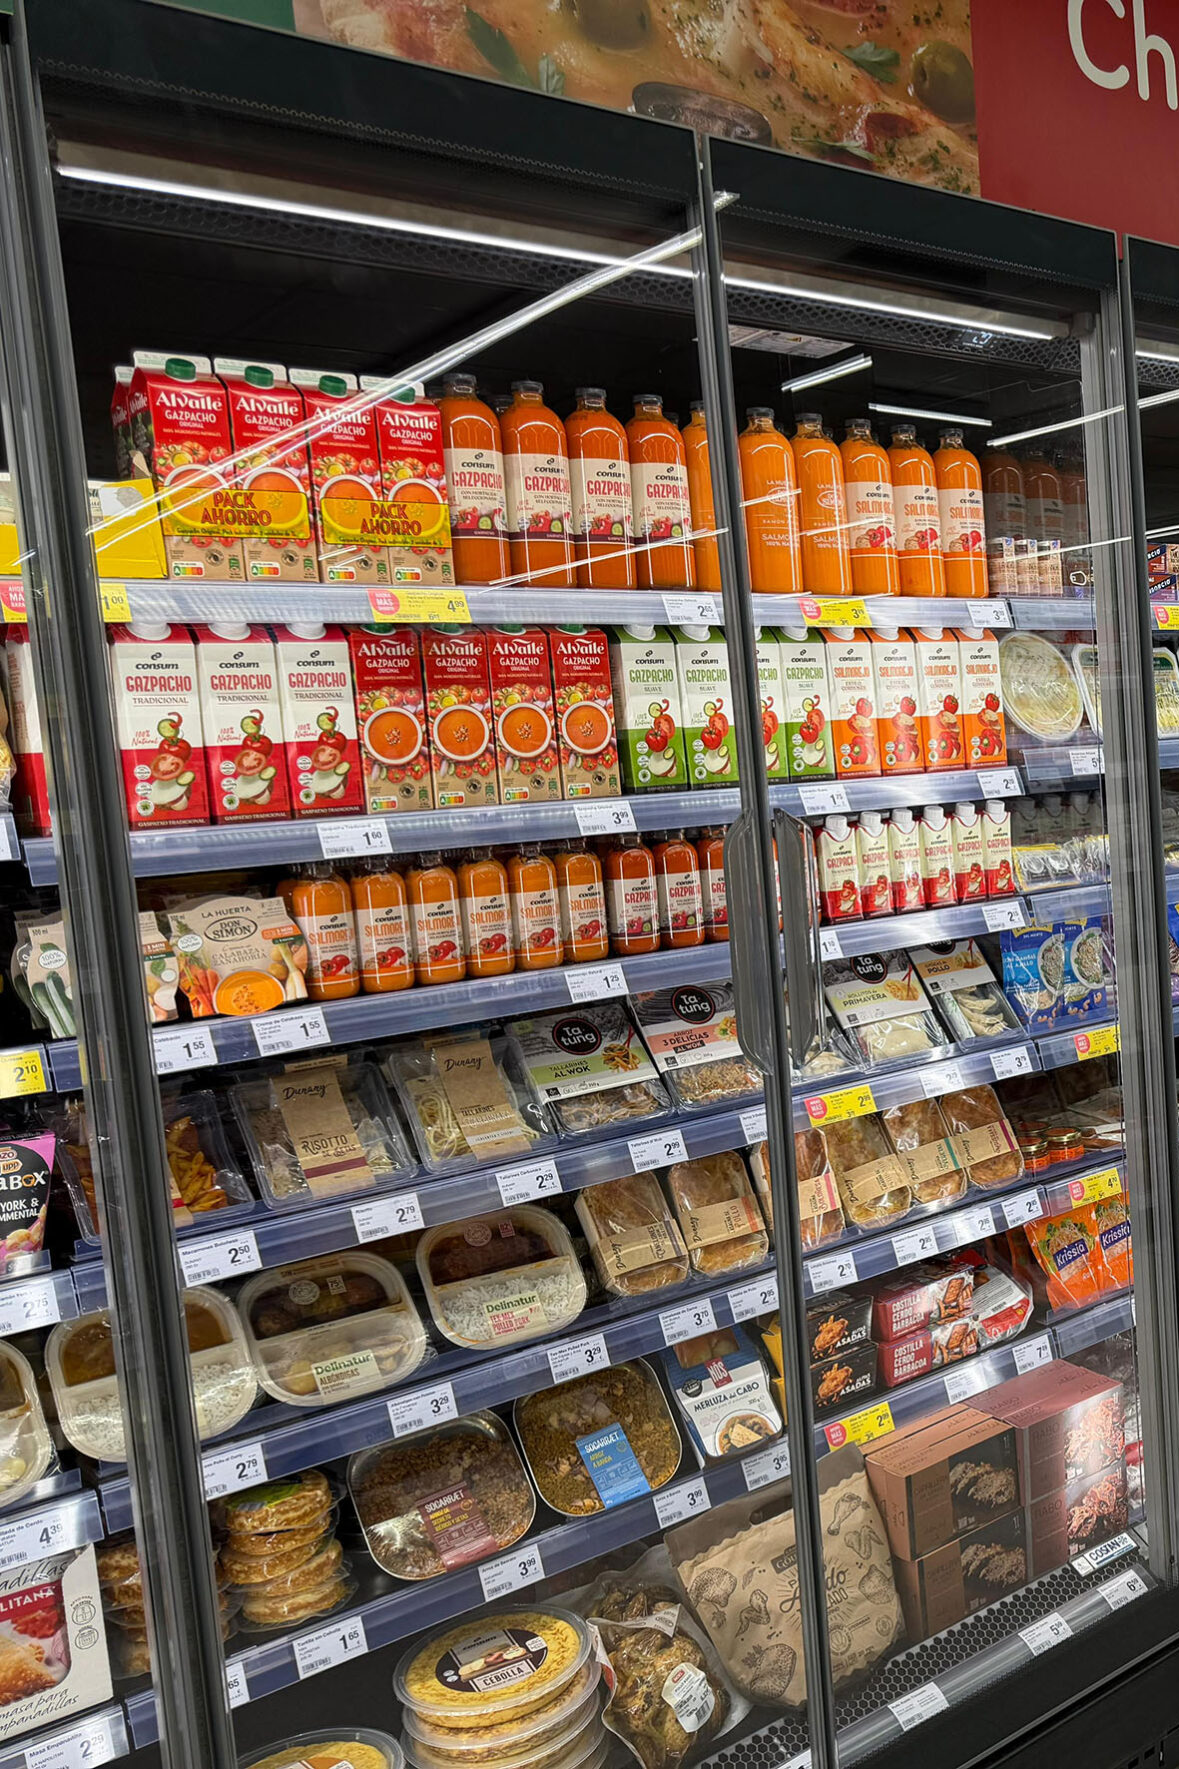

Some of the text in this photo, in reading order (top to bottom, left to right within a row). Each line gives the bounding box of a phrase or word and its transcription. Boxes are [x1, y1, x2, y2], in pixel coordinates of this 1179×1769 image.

[165, 410, 216, 423] GAZPACHO
[245, 415, 293, 427] GAZPACHO
[179, 421, 204, 429] ORIGINAL
[320, 424, 366, 436] GAZPACHO
[389, 429, 432, 441] GAZPACHO
[462, 461, 495, 469] consum
[213, 490, 255, 508] PACK
[201, 508, 272, 527] AHORRO
[370, 502, 408, 520] PACK
[360, 518, 422, 536] AHORRO
[136, 662, 179, 670] consum
[366, 658, 409, 668] GAZPACHO
[435, 658, 477, 666] GAZPACHO
[500, 657, 539, 666] GAZPACHO
[563, 657, 600, 665] GAZPACHO
[288, 672, 347, 687] GAZPACHO
[629, 669, 674, 683] GAZPACHO
[686, 669, 727, 682] GAZPACHO
[787, 668, 824, 680] GAZPACHO
[126, 676, 192, 692] GAZPACHO
[211, 675, 272, 690] GAZPACHO
[217, 694, 269, 702] TRADICIONAL
[215, 906, 252, 916] HUERTA
[220, 920, 240, 929] DON
[858, 956, 872, 965] Ta
[857, 962, 885, 975] tung
[927, 964, 950, 974] POLLO
[681, 994, 697, 1005] Ta
[843, 992, 887, 1008] PRIMAVERA
[678, 1001, 710, 1014] tung
[560, 1031, 596, 1046] tung
[563, 1026, 582, 1038] Ta
[669, 1032, 709, 1044] DELICIAS
[549, 1060, 588, 1072] TALLARINES
[567, 1065, 591, 1078] WOK
[461, 1105, 495, 1116] TALLARINES
[301, 1135, 348, 1155] RISOTTO
[1, 1198, 39, 1212] YORK &
[0, 1208, 37, 1221] MMENTAL
[1057, 1244, 1085, 1266] Krissia
[486, 1295, 537, 1313] Delinatur
[892, 1293, 920, 1313] COSTILLA
[892, 1309, 913, 1322] CERDO
[893, 1313, 924, 1332] BARBACOA
[836, 1330, 866, 1348] ASADAS
[894, 1339, 924, 1358] COSTILLA
[315, 1354, 372, 1375] Delinatur
[894, 1355, 914, 1368] CERDO
[894, 1358, 927, 1378] BARBACOA
[840, 1377, 871, 1395] ASADAS
[694, 1394, 728, 1412] MERLUZA
[736, 1382, 759, 1395] CABO
[1089, 1540, 1118, 1561] COSTAN
[0, 1688, 69, 1721] masa para
[0, 1694, 79, 1735] mpanadillas
